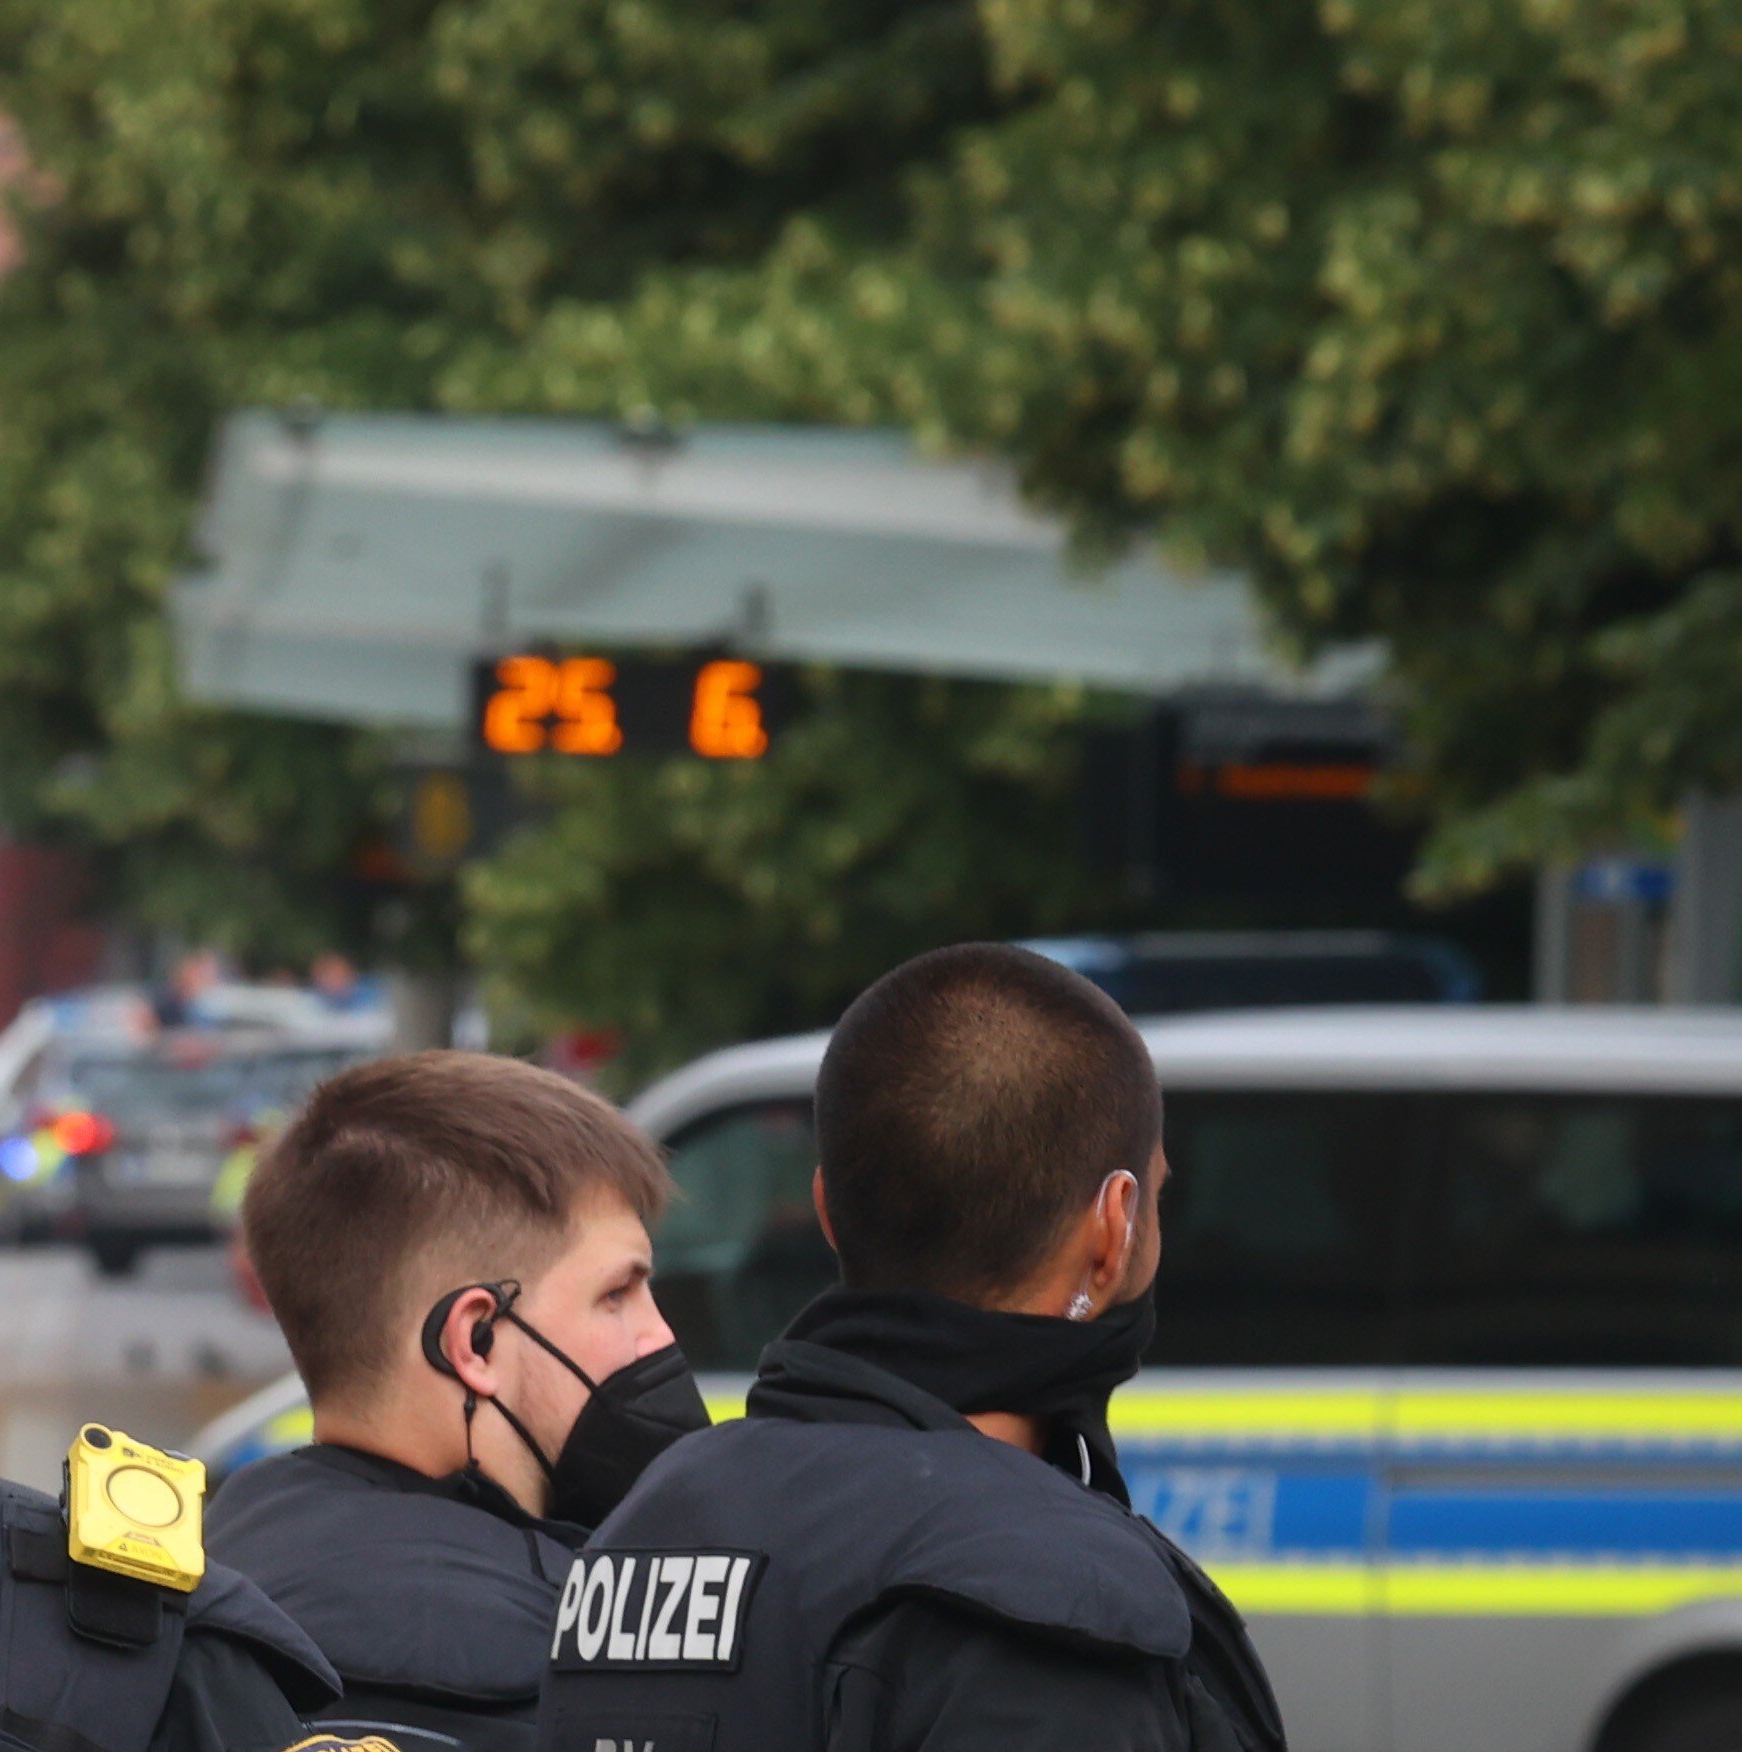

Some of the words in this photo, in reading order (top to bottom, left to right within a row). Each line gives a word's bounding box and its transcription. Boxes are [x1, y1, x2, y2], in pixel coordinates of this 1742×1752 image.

[484, 655, 623, 755] 25
[688, 659, 769, 759] 6
[550, 1554, 751, 1662] POLIZEI
